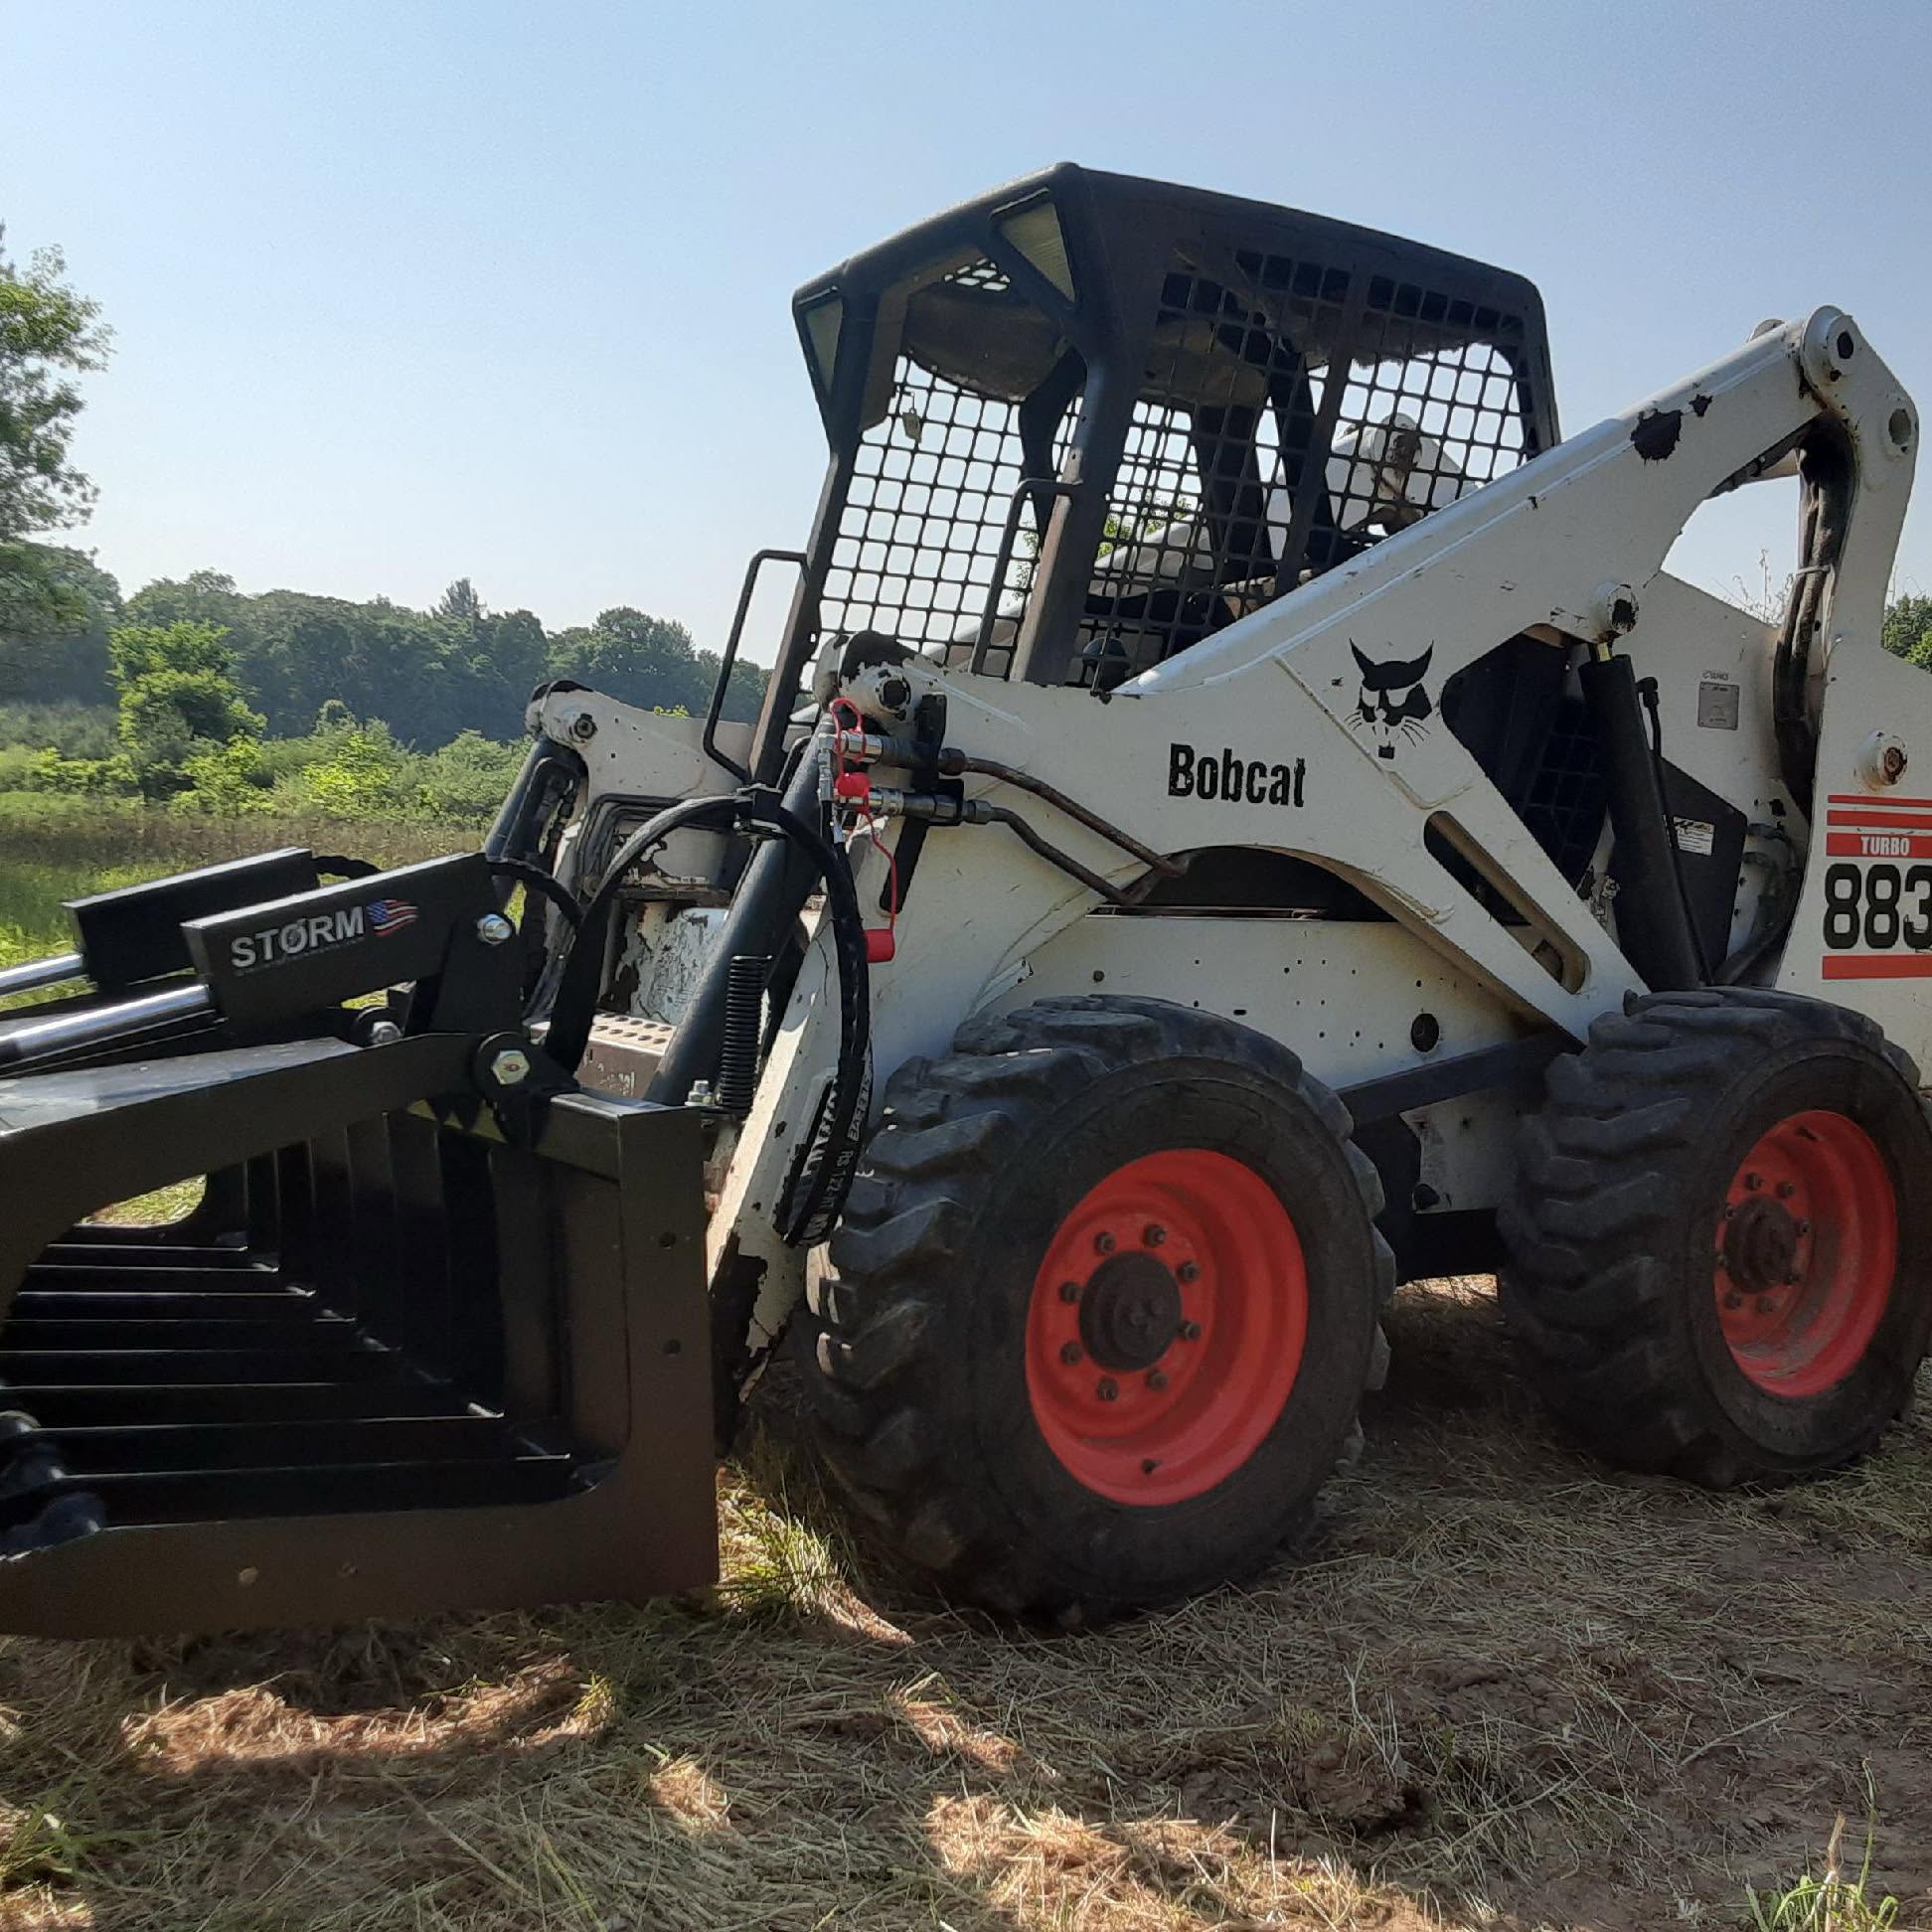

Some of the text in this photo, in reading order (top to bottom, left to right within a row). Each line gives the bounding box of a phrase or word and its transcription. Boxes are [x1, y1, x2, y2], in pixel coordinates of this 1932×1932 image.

[1168, 742, 1306, 808] Bobcat
[1860, 836, 1911, 856] TURBO
[231, 906, 365, 968] STORM
[1823, 863, 1932, 950] 883
